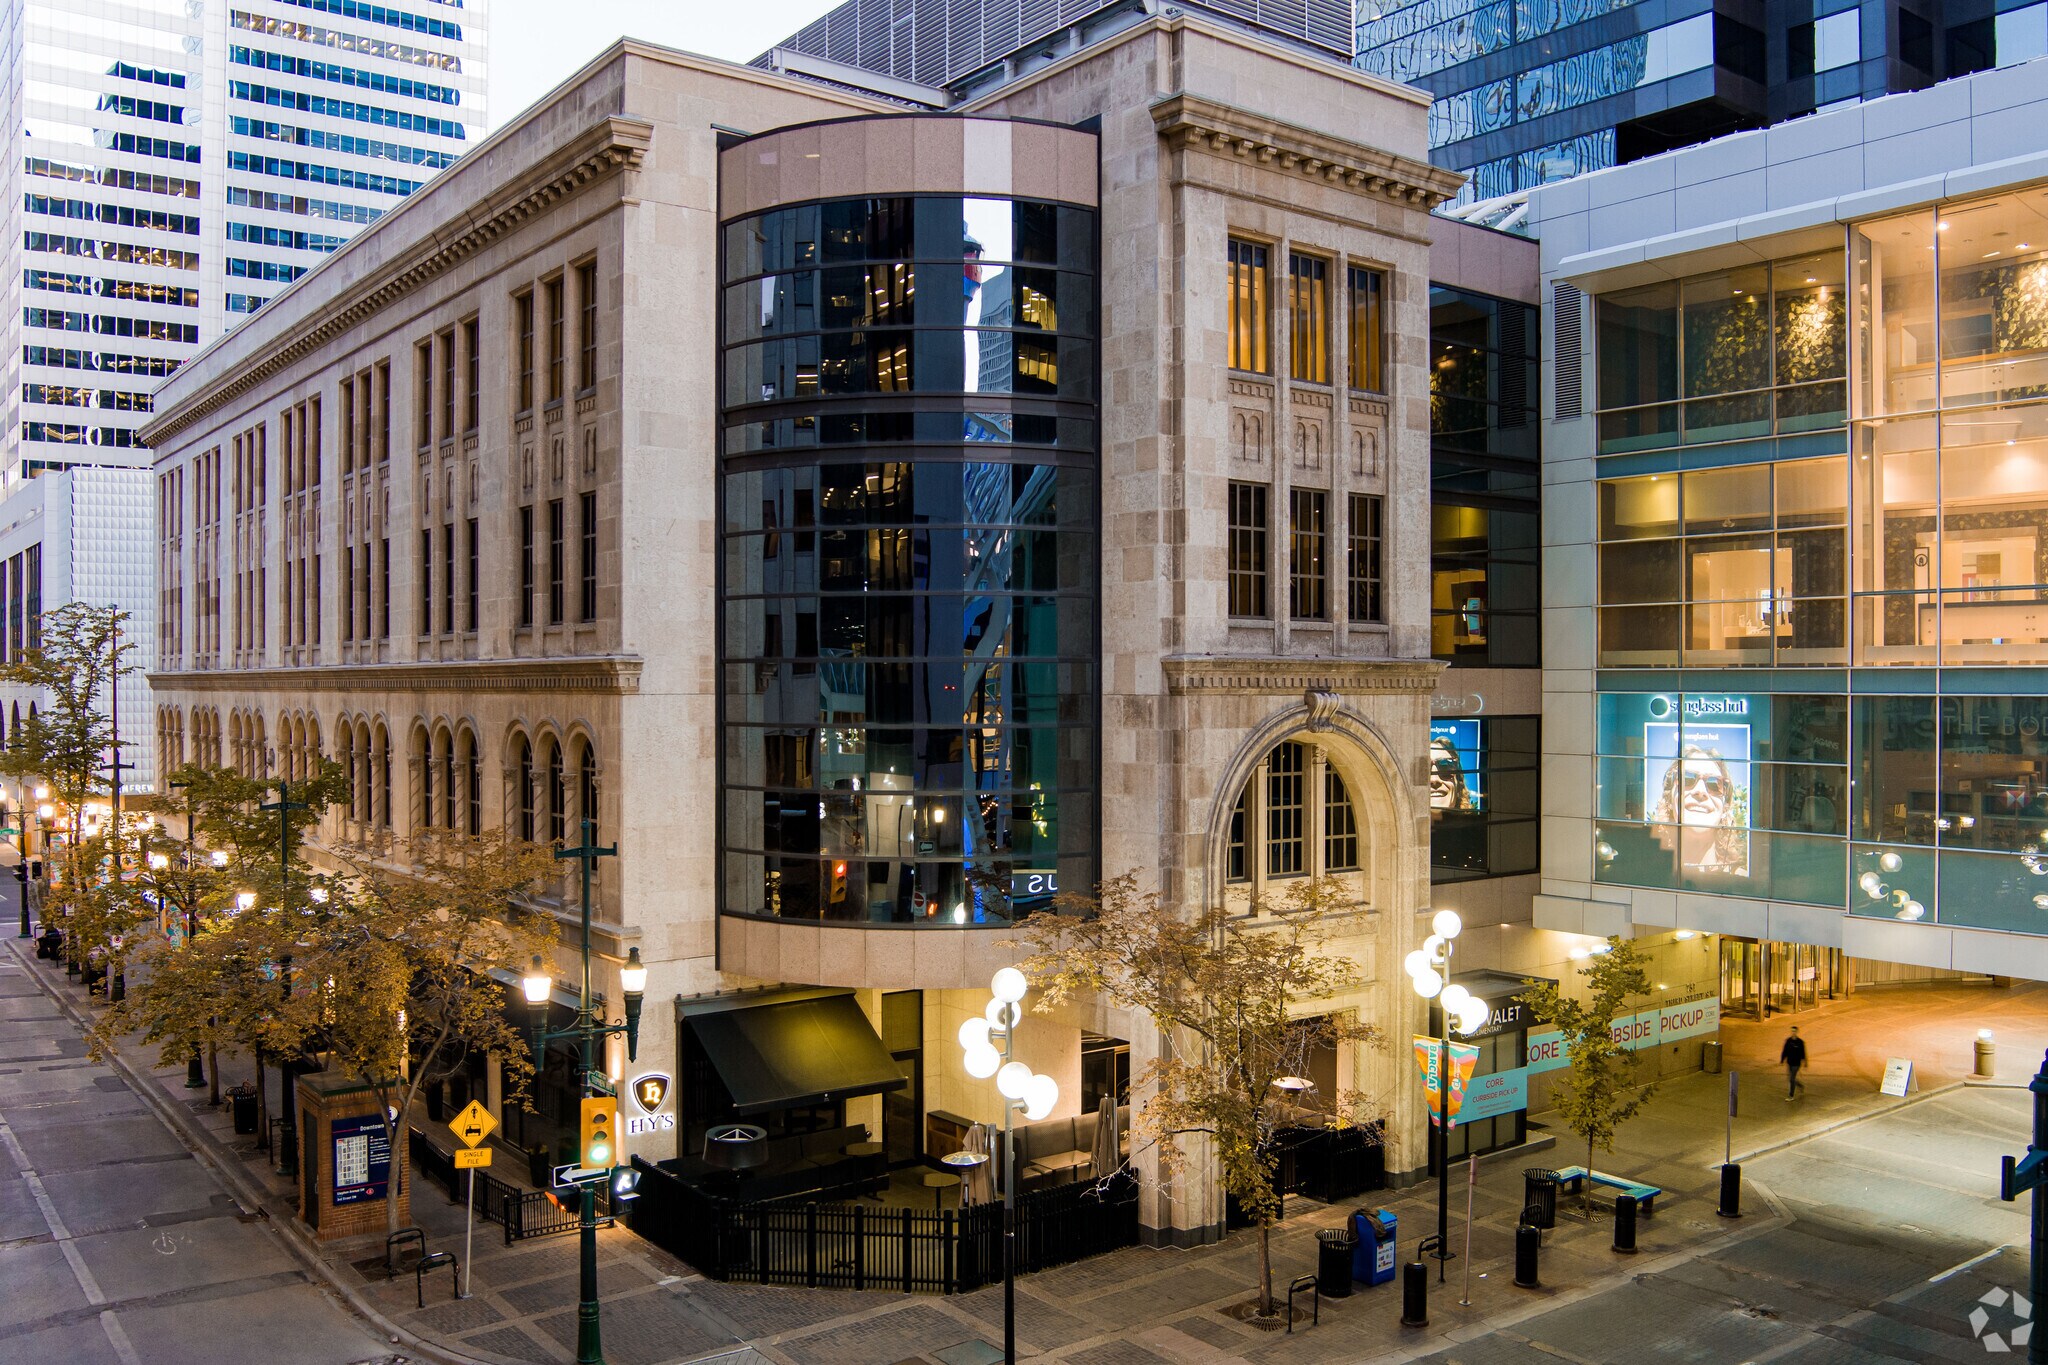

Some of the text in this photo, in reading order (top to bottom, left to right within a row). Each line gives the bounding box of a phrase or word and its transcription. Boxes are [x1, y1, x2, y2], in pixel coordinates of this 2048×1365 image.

[1669, 698, 1746, 716] snglass hut
[1943, 715, 1991, 736] THE
[119, 783, 155, 794] NFREW
[1486, 1006, 1521, 1026] VALET
[1460, 1024, 1502, 1040] COLIMENTARY
[1527, 1009, 1704, 1064] ORE BSIDE PICKUP
[1427, 1044, 1438, 1092] BARCLAY
[1485, 1077, 1505, 1089] CORE
[1472, 1091, 1498, 1103] CURBSIDE
[463, 1150, 484, 1158] SINGLE
